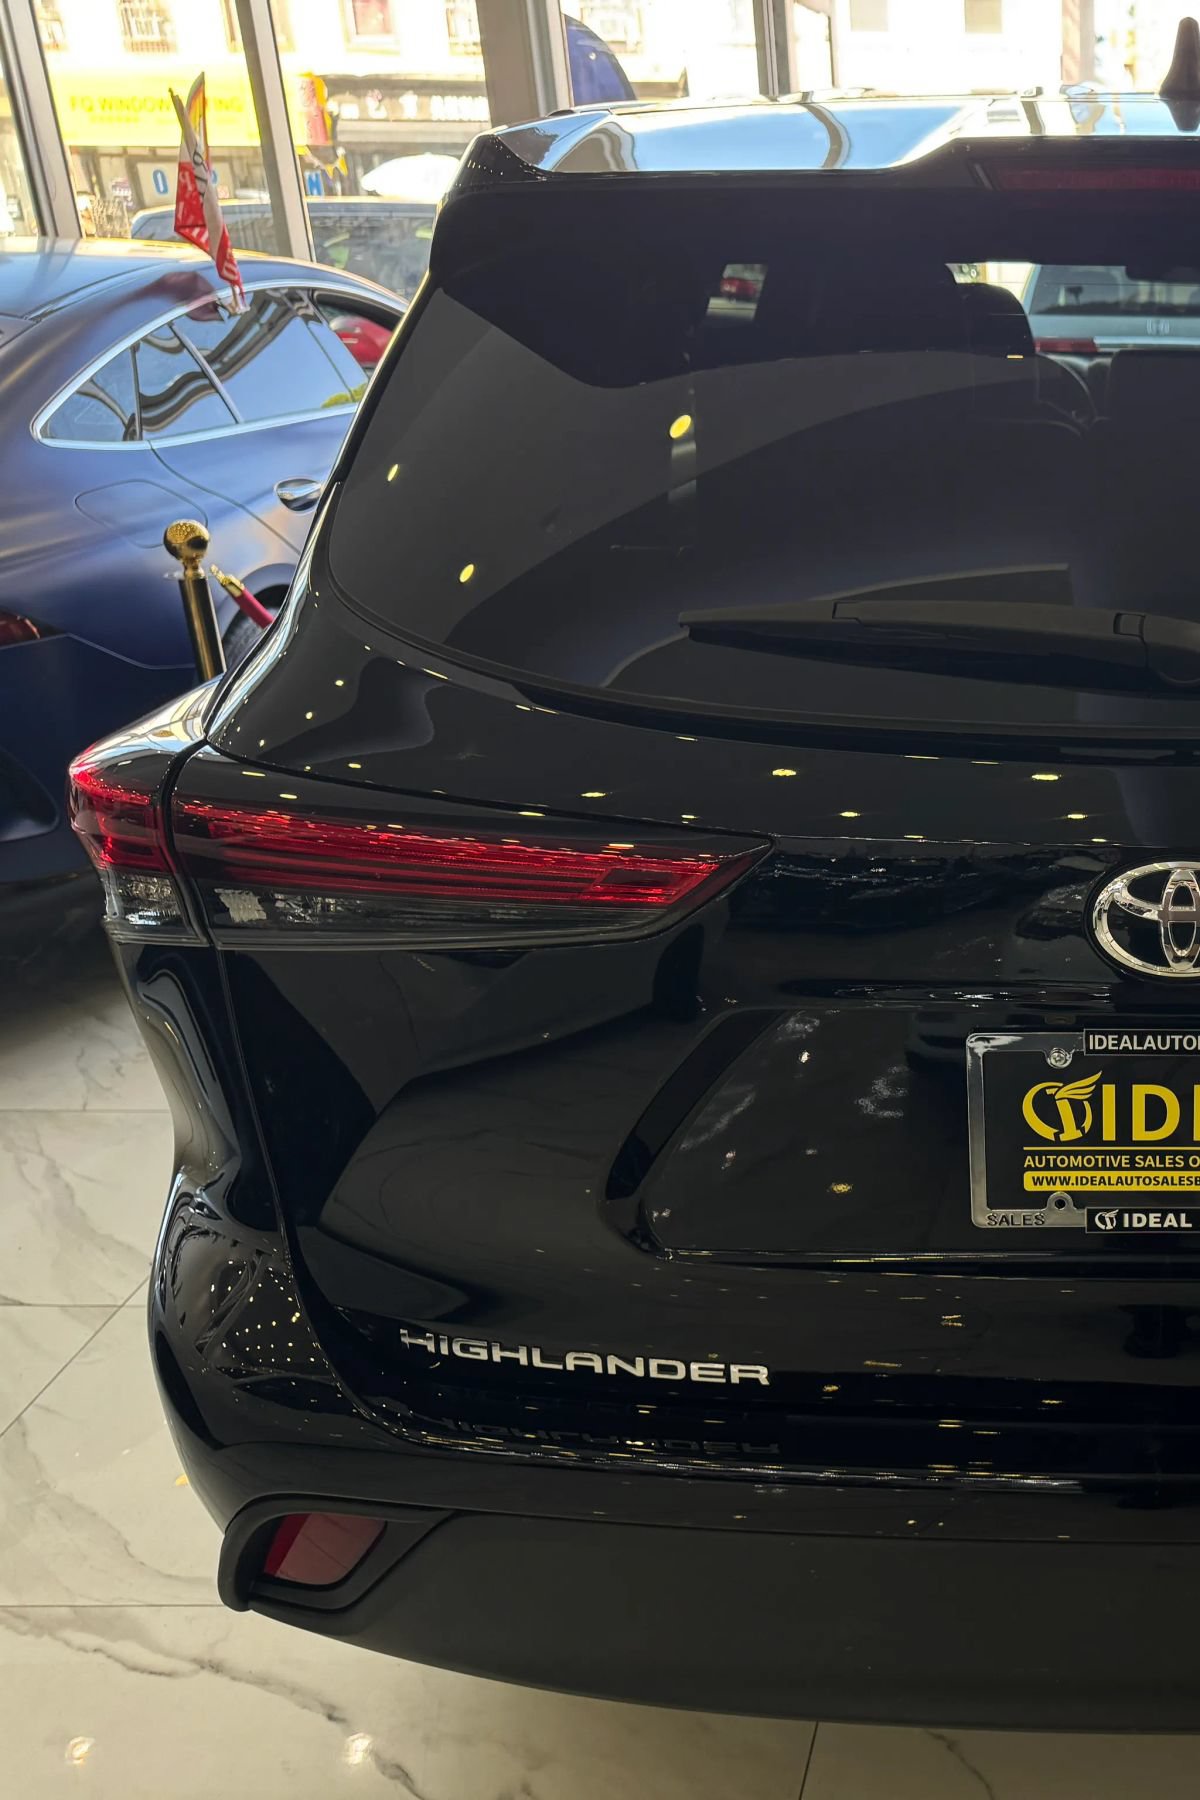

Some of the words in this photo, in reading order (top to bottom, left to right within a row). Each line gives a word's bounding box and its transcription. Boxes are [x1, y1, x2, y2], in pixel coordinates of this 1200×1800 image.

[1023, 1154, 1131, 1169] AUTOMOTIVE
[1134, 1154, 1184, 1169] SALES
[986, 1212, 1046, 1227] SALES
[1122, 1212, 1193, 1229] IDEAL
[400, 1328, 771, 1386] HIGHLANDER
